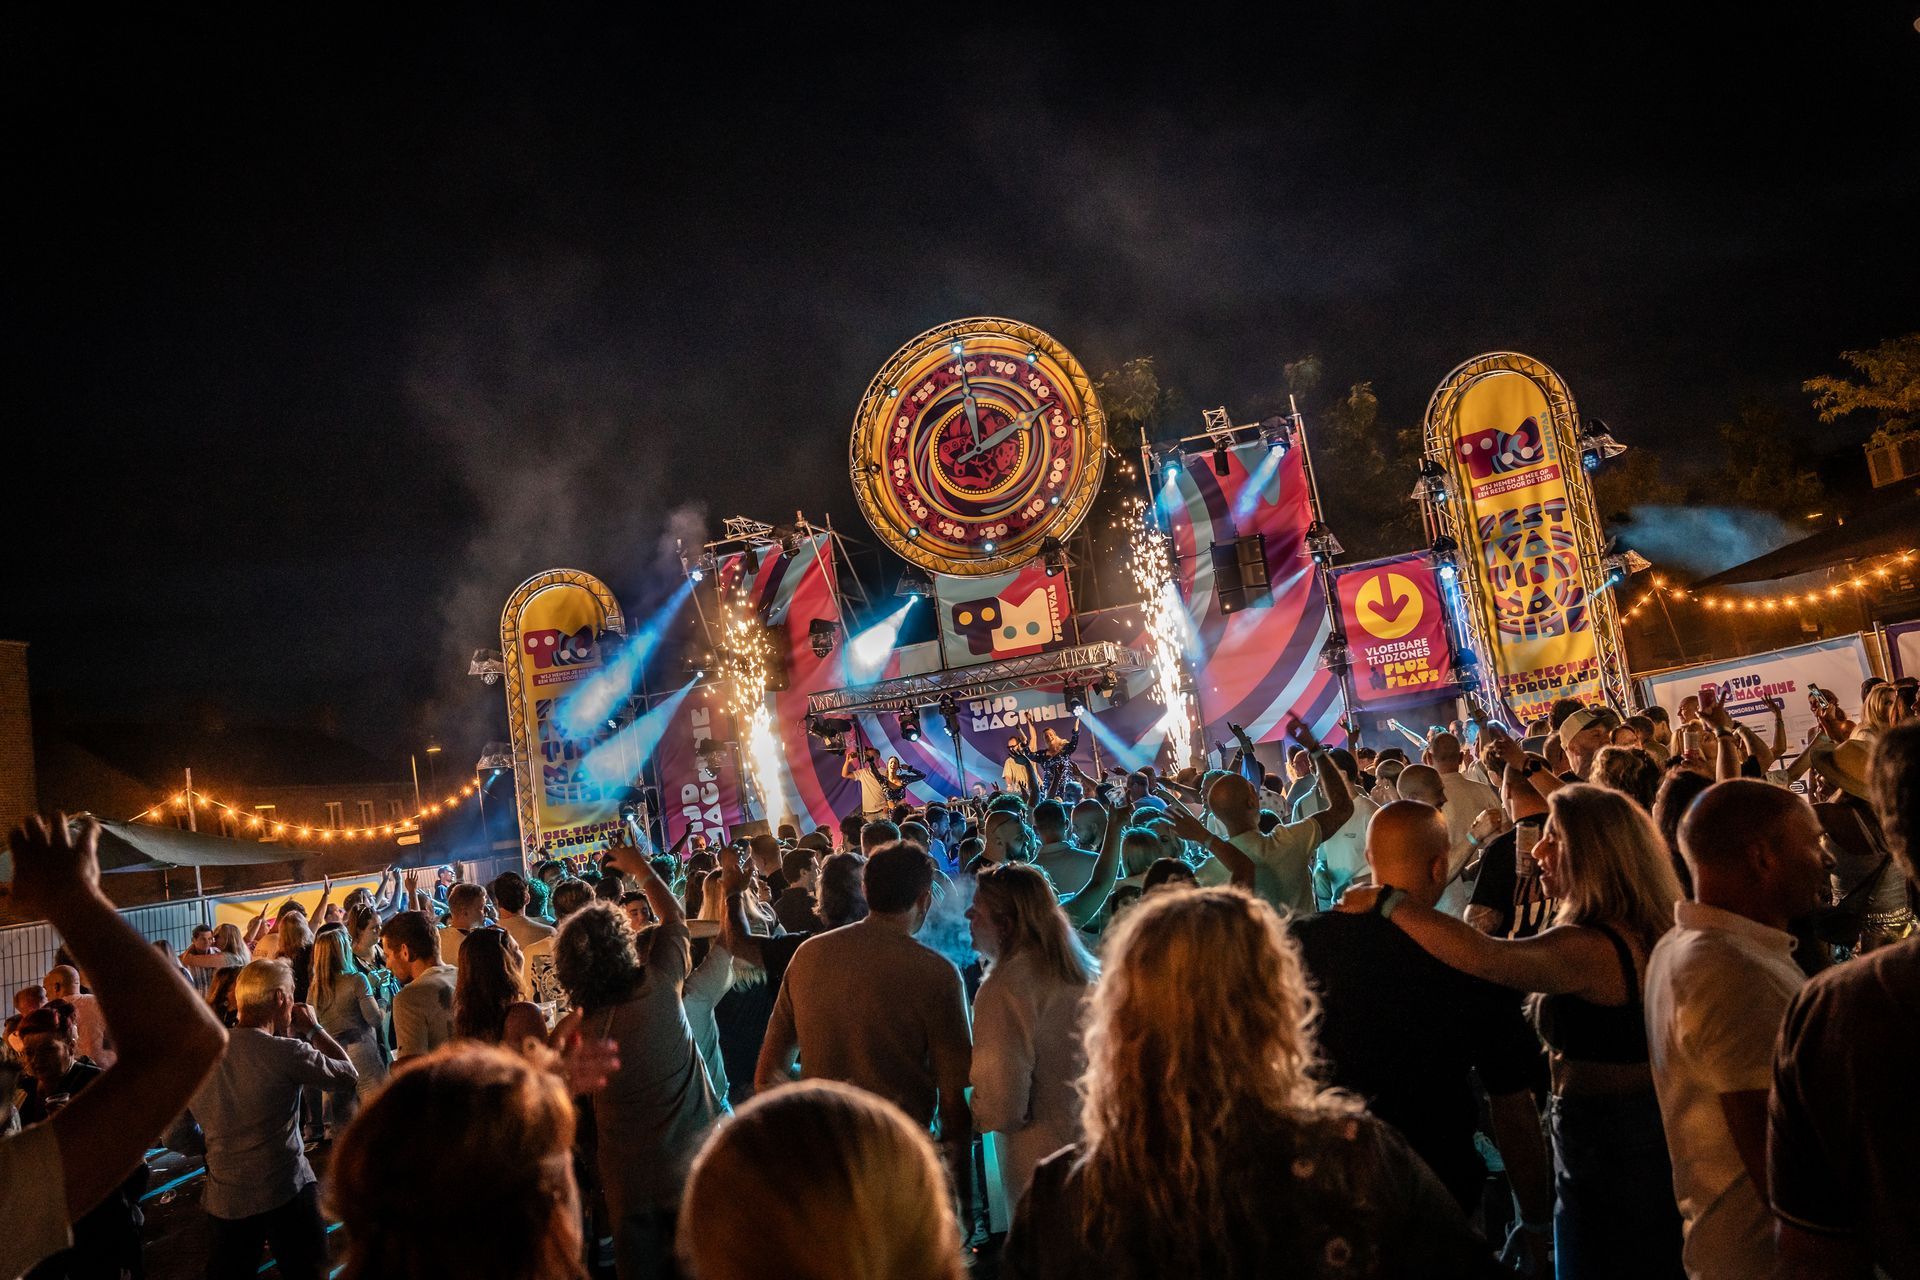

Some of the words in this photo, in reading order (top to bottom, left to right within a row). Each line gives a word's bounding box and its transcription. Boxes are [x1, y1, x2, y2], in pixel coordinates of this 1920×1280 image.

[1507, 481, 1526, 490] DOOR
[1048, 584, 1063, 641] FESTIVAL
[1365, 638, 1428, 656] VLOEIBARE
[1367, 647, 1430, 665] TIJDZONES
[1566, 668, 1599, 685] AND
[1732, 674, 1761, 689] TIJD
[1735, 680, 1796, 701] MACHINE
[970, 696, 1018, 717] TIJD
[1727, 705, 1755, 716] PONSOREN
